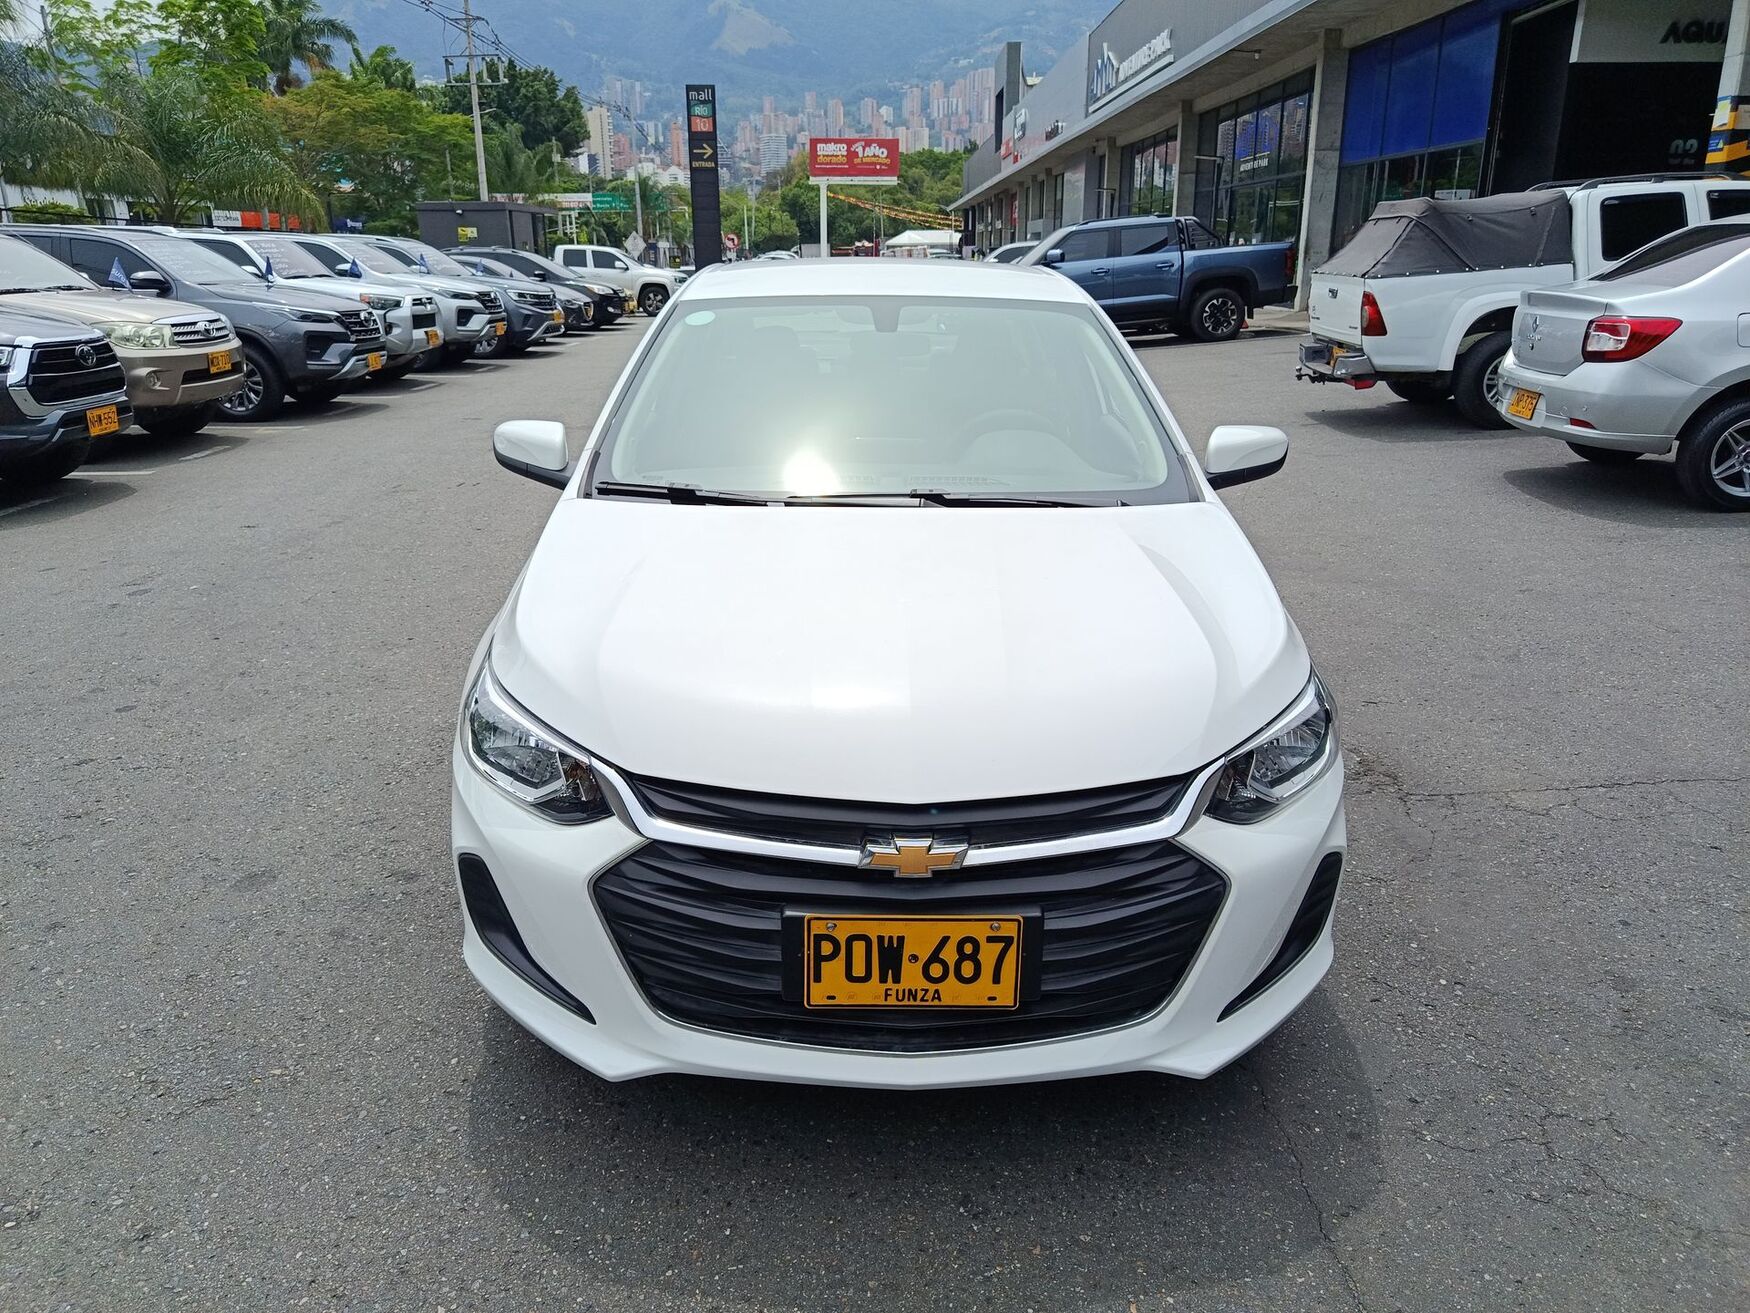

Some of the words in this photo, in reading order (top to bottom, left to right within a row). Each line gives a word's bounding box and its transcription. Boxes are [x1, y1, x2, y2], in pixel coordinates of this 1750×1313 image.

[1659, 20, 1728, 44] AQU
[689, 89, 712, 100] mall
[696, 119, 709, 131] 10
[817, 142, 847, 152] makro
[817, 155, 847, 164] dorado
[884, 988, 942, 1003] FUNZA
